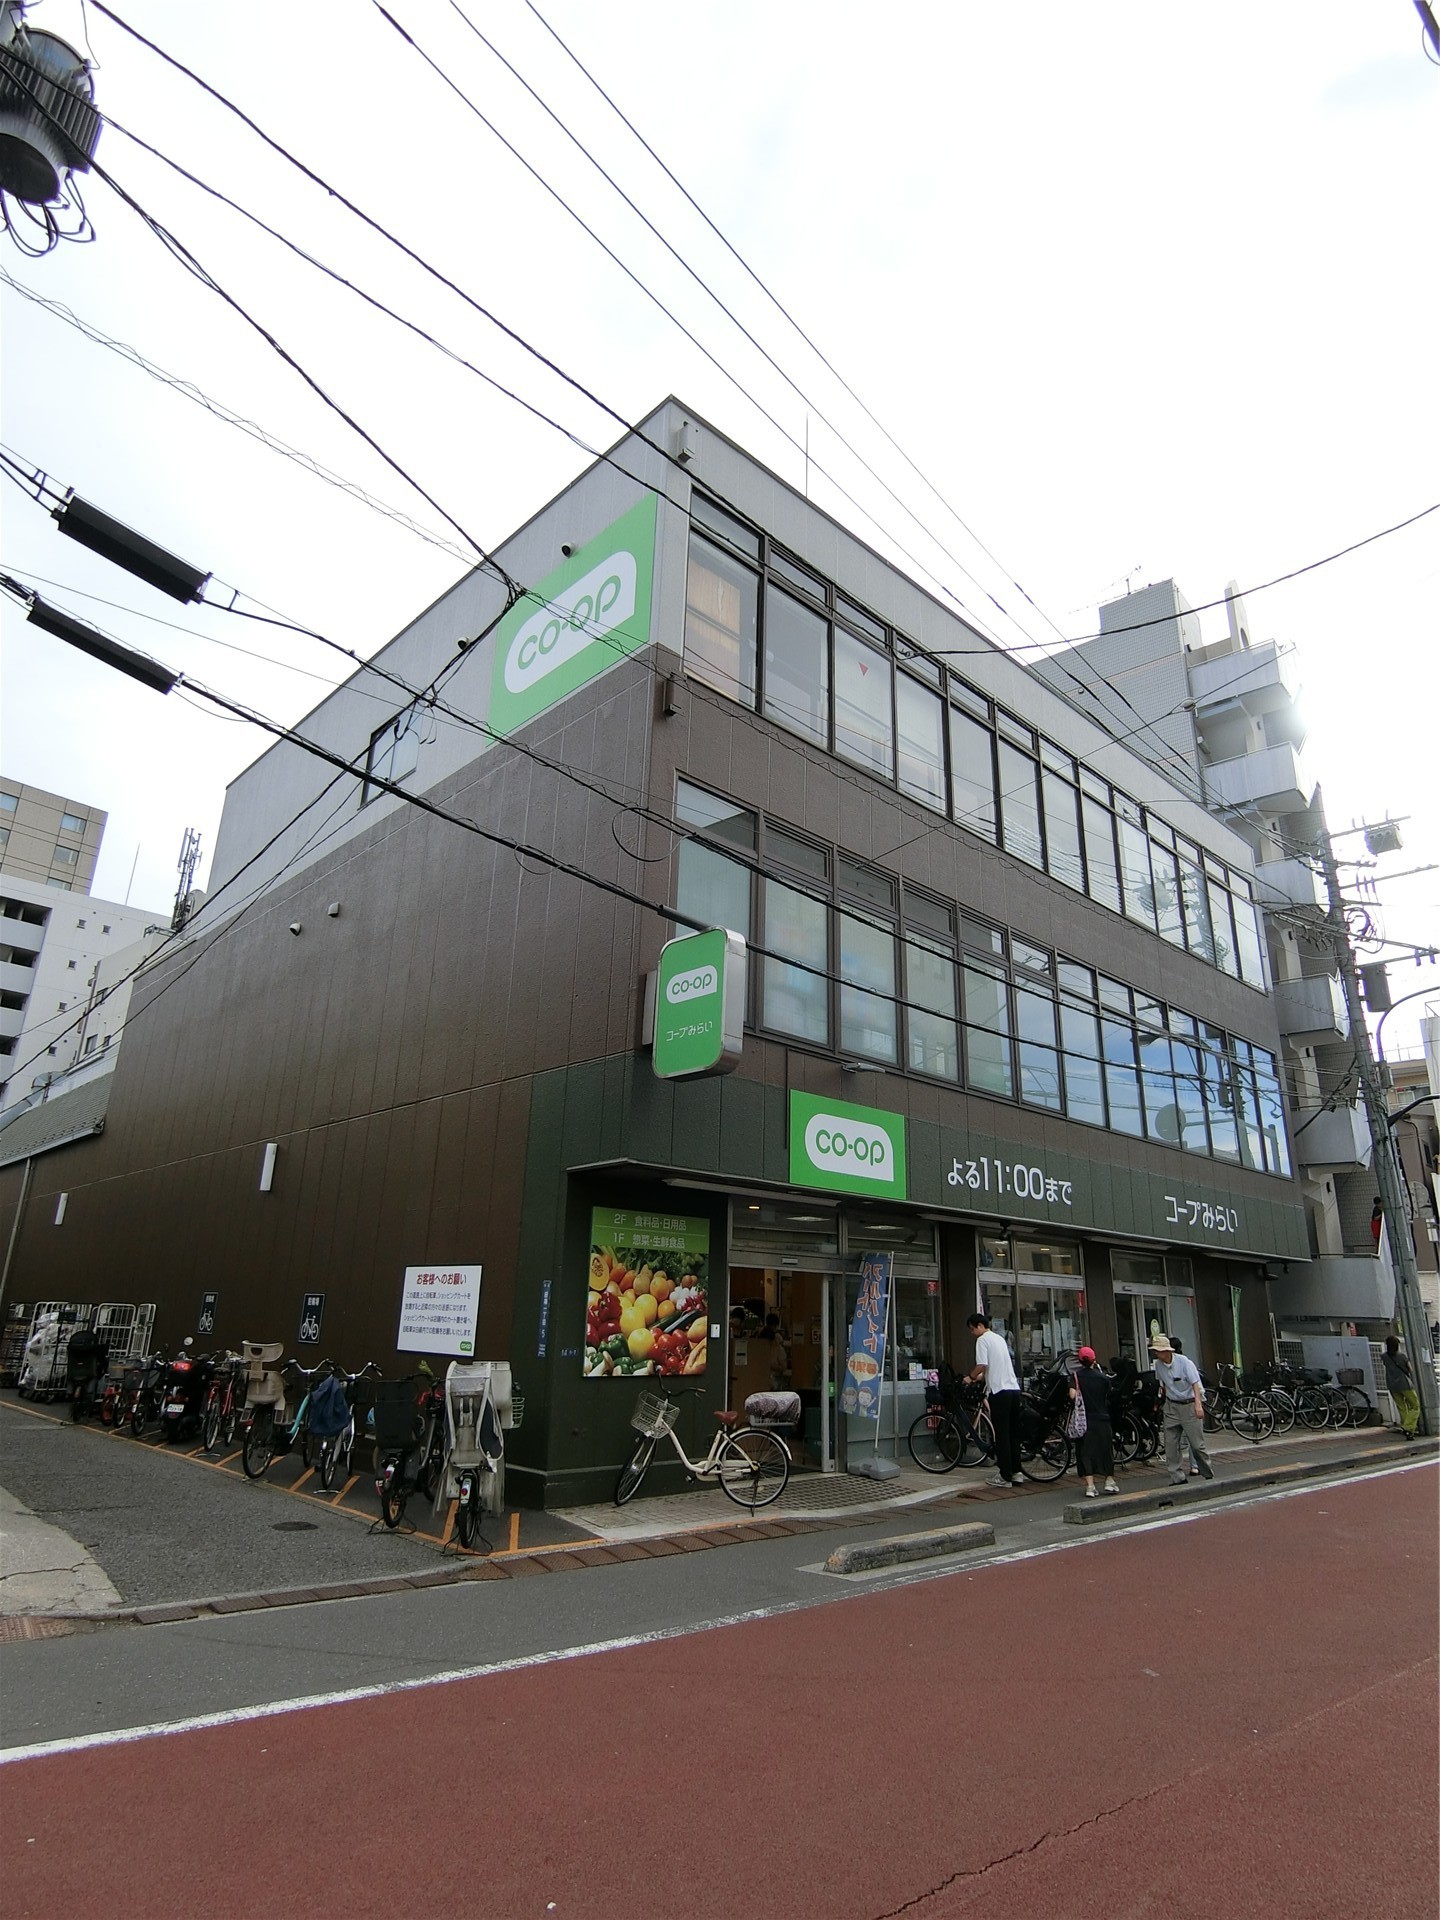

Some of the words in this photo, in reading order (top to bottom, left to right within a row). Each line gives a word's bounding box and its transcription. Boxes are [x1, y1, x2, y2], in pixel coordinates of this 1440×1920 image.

[666, 1020, 713, 1042] コープみらい
[946, 1155, 1073, 1206] よる11:00まで
[613, 1213, 627, 1224] 2F
[1164, 1195, 1239, 1233] コープみらい
[613, 1232, 625, 1243] 1F
[416, 1273, 467, 1285] お客様へのお願い
